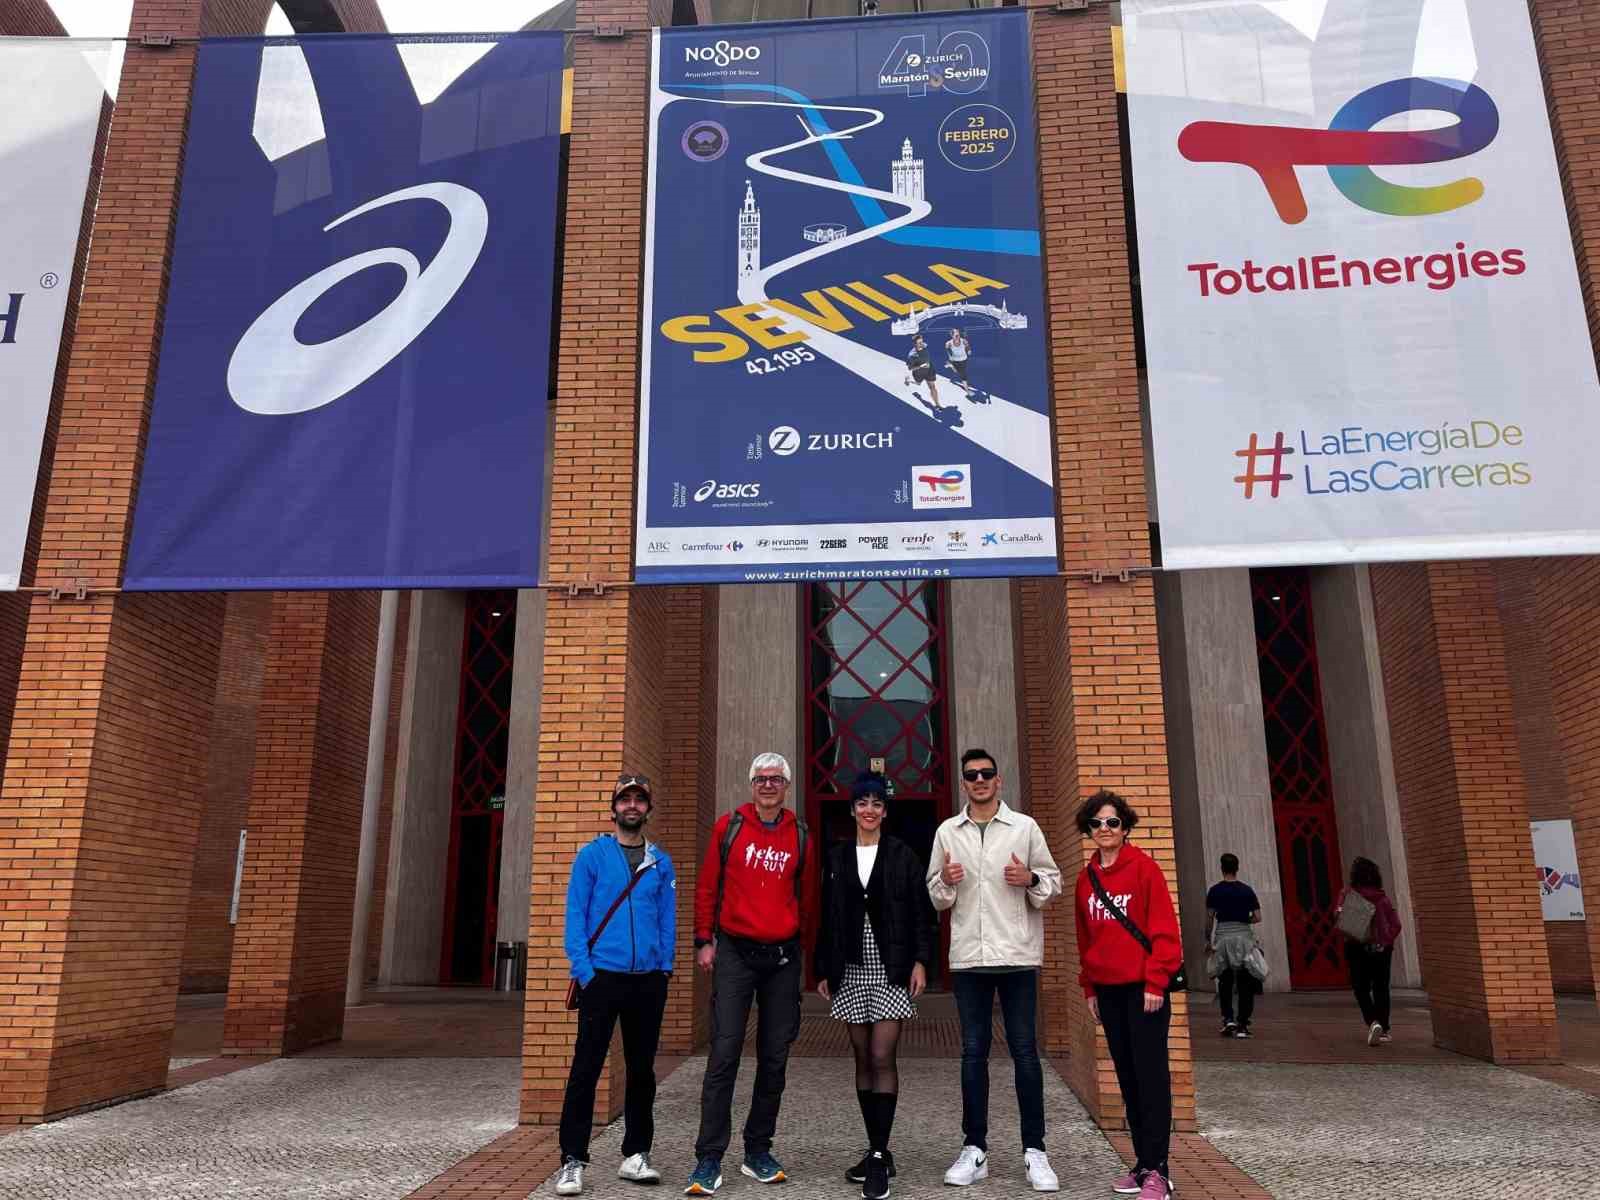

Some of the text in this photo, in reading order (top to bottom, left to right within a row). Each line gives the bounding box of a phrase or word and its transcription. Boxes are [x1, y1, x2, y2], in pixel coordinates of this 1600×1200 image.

[925, 53, 963, 64] ZURICH
[880, 66, 988, 84] Maratón Sevilla
[967, 116, 985, 128] 23
[944, 128, 1009, 142] FEBRERO
[960, 142, 995, 155] 2025
[1187, 242, 1527, 297] TotalEnergies
[660, 263, 1011, 363] SEVILLA
[745, 347, 816, 375] 42,195
[807, 432, 894, 450] ZURICH
[1300, 420, 1524, 456] LaEnergíaDe
[1304, 459, 1532, 495] LasCarreras
[858, 536, 888, 544] POWER
[902, 533, 935, 545] renfe
[1001, 533, 1044, 543] CaixaBank
[648, 541, 671, 551] ABC
[682, 542, 723, 551] Carrefour
[744, 567, 950, 580] www.zurichmaratonsevilla.es
[763, 860, 785, 872] RUN
